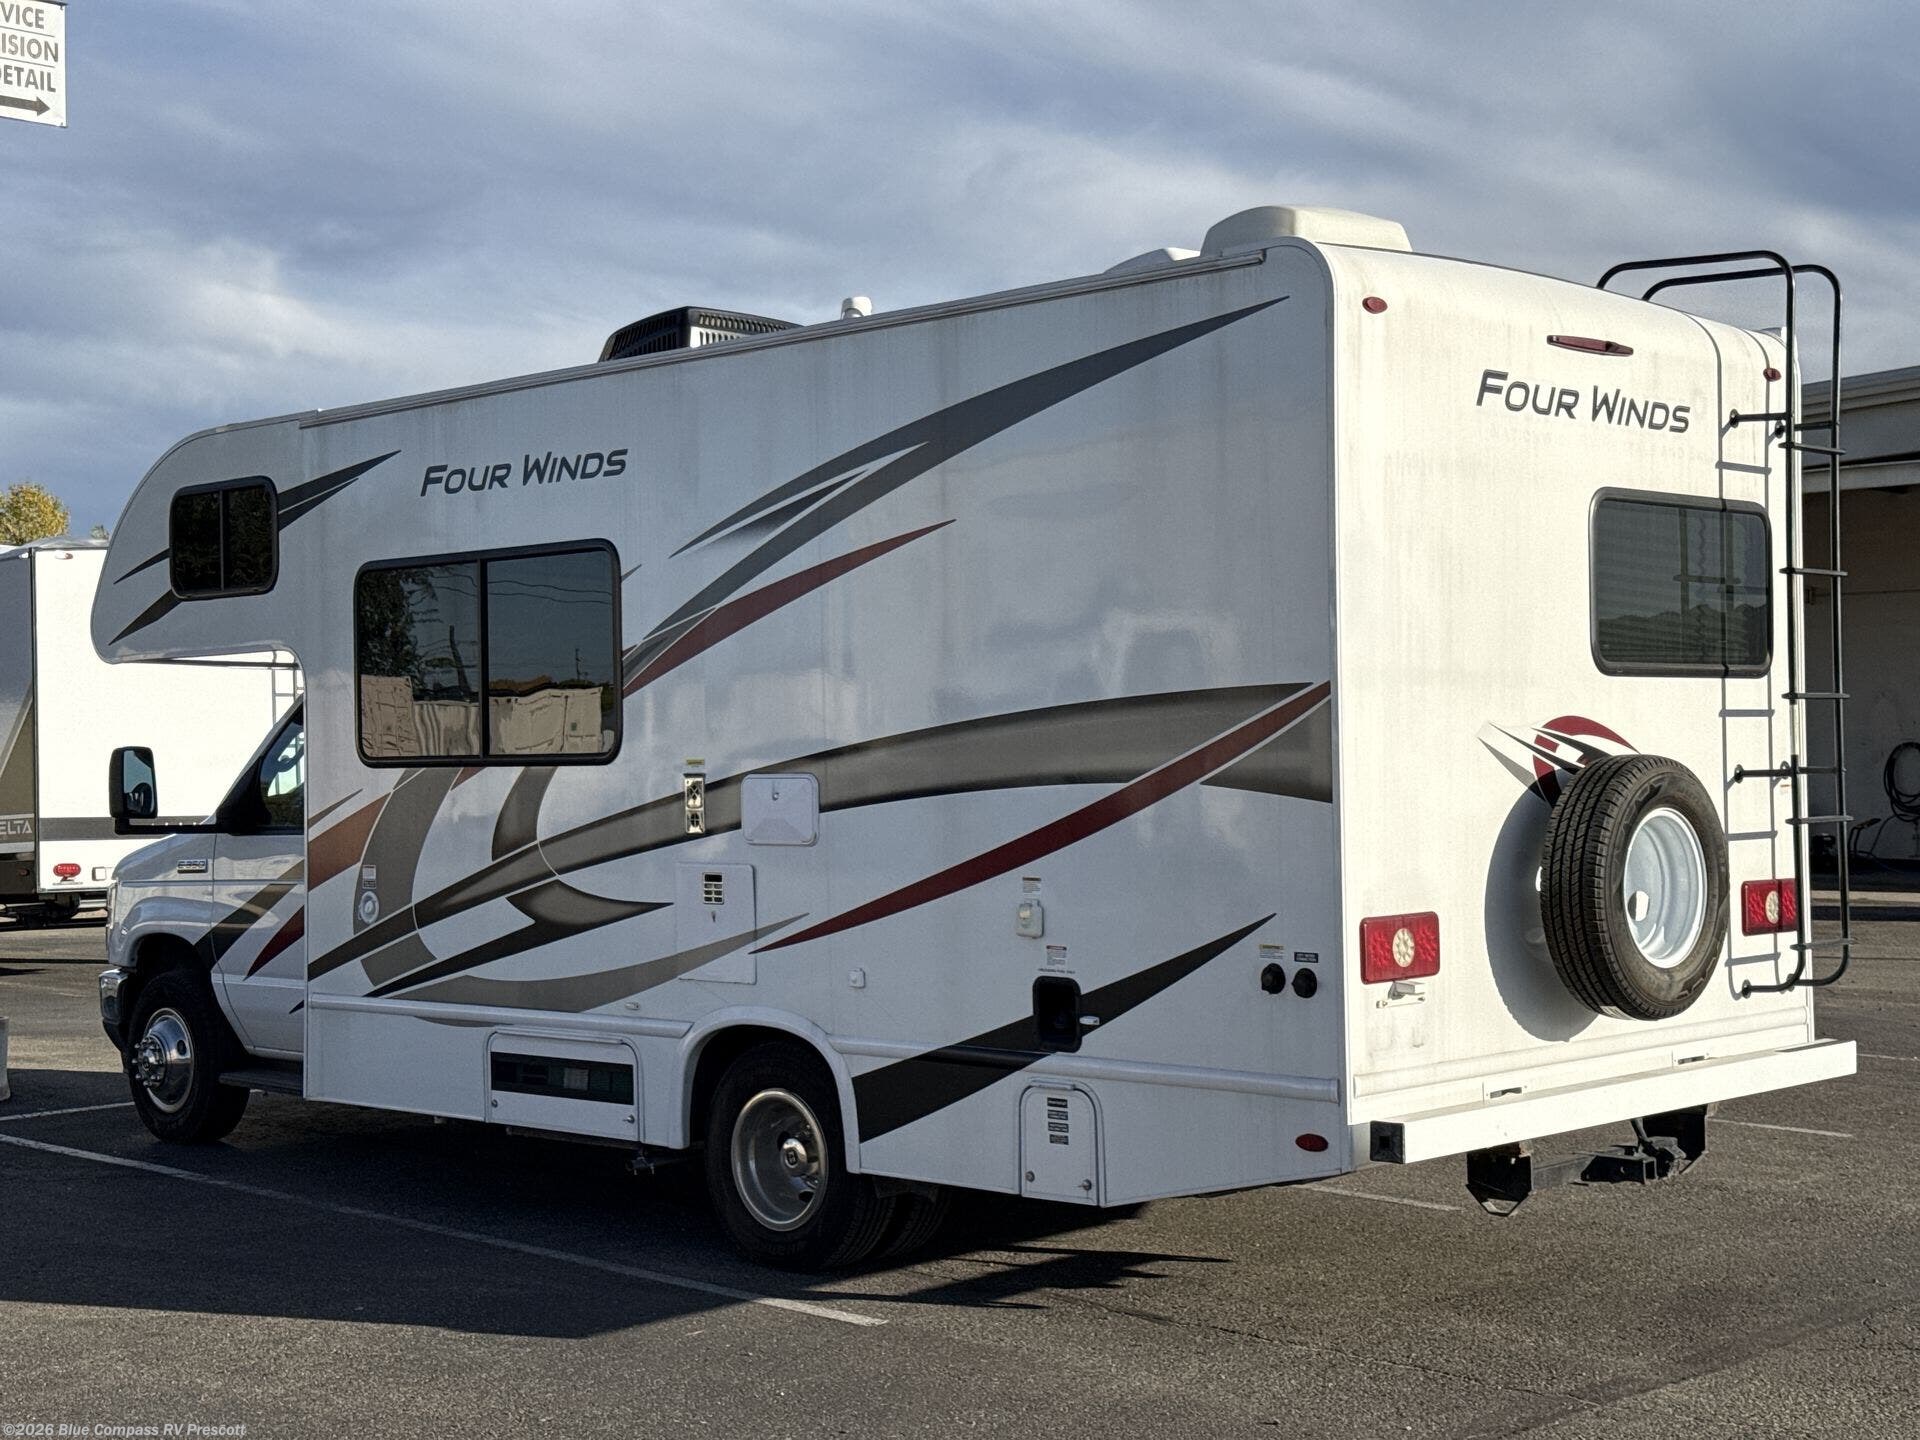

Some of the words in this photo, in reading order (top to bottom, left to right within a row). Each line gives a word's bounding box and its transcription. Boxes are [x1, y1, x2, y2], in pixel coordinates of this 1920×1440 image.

[0, 2, 45, 29] VICE
[1, 33, 59, 62] ISION
[0, 64, 56, 93] ETAIL
[1476, 368, 1580, 419] FOUR
[1591, 385, 1691, 434] WINDS
[420, 463, 512, 497] FOUR
[522, 448, 628, 486] WINDS
